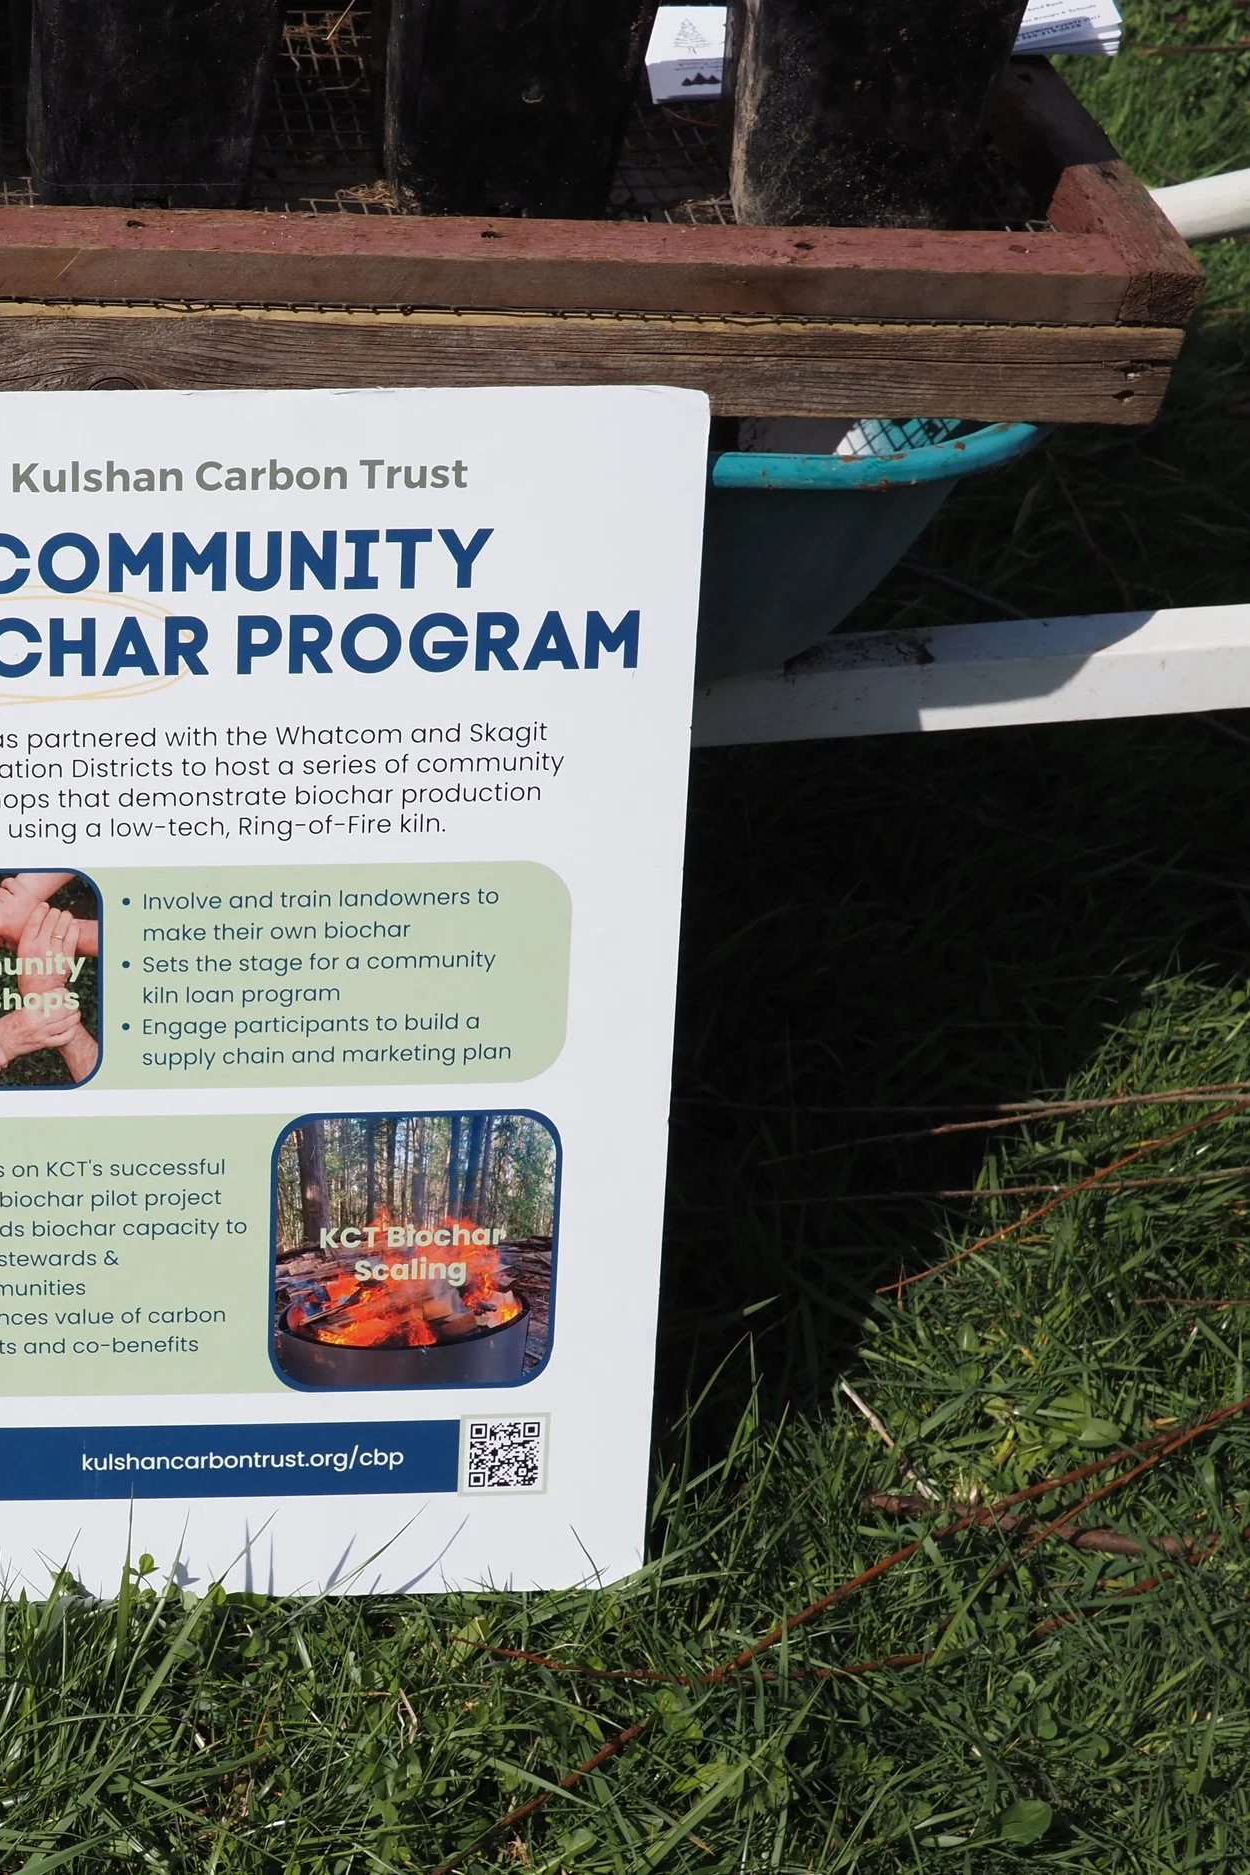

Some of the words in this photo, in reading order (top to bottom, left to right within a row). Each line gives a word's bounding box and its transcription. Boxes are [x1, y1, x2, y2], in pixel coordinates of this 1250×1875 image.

[12, 460, 183, 493] Kulshan
[195, 458, 348, 492] Carbon
[359, 459, 469, 490] Trust
[236, 609, 641, 675] PROGRAM
[27, 727, 156, 755] partnered
[164, 726, 217, 747] with
[225, 726, 267, 746] the
[275, 725, 402, 746] Whatcom
[411, 722, 461, 744] and
[470, 720, 548, 748] Skagit
[72, 757, 173, 778] Districts
[181, 758, 207, 777] to
[215, 756, 270, 776] host
[278, 760, 294, 776] a
[302, 754, 376, 775] series
[384, 753, 409, 774] of
[416, 750, 565, 777] community
[57, 788, 110, 808] that
[118, 787, 287, 808] demonstrate
[295, 784, 394, 805] biochar
[401, 781, 541, 810] production
[8, 818, 77, 845] using
[85, 822, 101, 838] a
[110, 816, 230, 840] low-tech,
[239, 813, 392, 842] Ring-of-Fire
[400, 812, 446, 833] kiln.
[143, 891, 222, 910] Involve
[229, 890, 273, 909] and
[280, 889, 331, 908] train
[339, 888, 471, 907] landowners
[477, 888, 499, 905] to
[143, 923, 207, 942] make
[213, 922, 264, 941] their
[270, 925, 317, 940] own
[324, 920, 411, 939] biochar
[143, 956, 189, 973] Sets
[195, 954, 232, 972] the
[239, 955, 303, 977] stage
[309, 952, 340, 971] for
[345, 956, 360, 970] a
[367, 949, 497, 973] community
[143, 986, 178, 1004] kiln
[186, 986, 234, 1004] loan
[241, 987, 340, 1009] program
[143, 1018, 227, 1041] Engage
[234, 1015, 369, 1039] participants
[375, 1015, 398, 1031] to
[404, 1012, 459, 1031] build
[465, 1016, 480, 1030] a
[142, 1047, 216, 1071] supply
[222, 1046, 284, 1065] chain
[291, 1046, 335, 1064] and
[342, 1043, 456, 1067] marketing
[463, 1042, 512, 1066] plan
[11, 1164, 39, 1178] on
[46, 1159, 103, 1177] KCT's
[110, 1158, 225, 1177] successful
[0, 1190, 84, 1208] biochar
[91, 1189, 138, 1212] pilot
[145, 1188, 222, 1212] project
[32, 1219, 116, 1237] biochar
[122, 1217, 220, 1241] capacity
[225, 1219, 248, 1235] to
[319, 1227, 380, 1249] KCT
[387, 1224, 505, 1248] Biochar
[103, 1249, 120, 1266] &
[354, 1256, 468, 1287] Scaling
[54, 1308, 115, 1325] value
[120, 1307, 142, 1324] of
[148, 1306, 226, 1324] carbon
[23, 1337, 66, 1355] and
[72, 1335, 199, 1354] co-benefits
[82, 1444, 404, 1472] kulshancarbontrust.org/cbp
